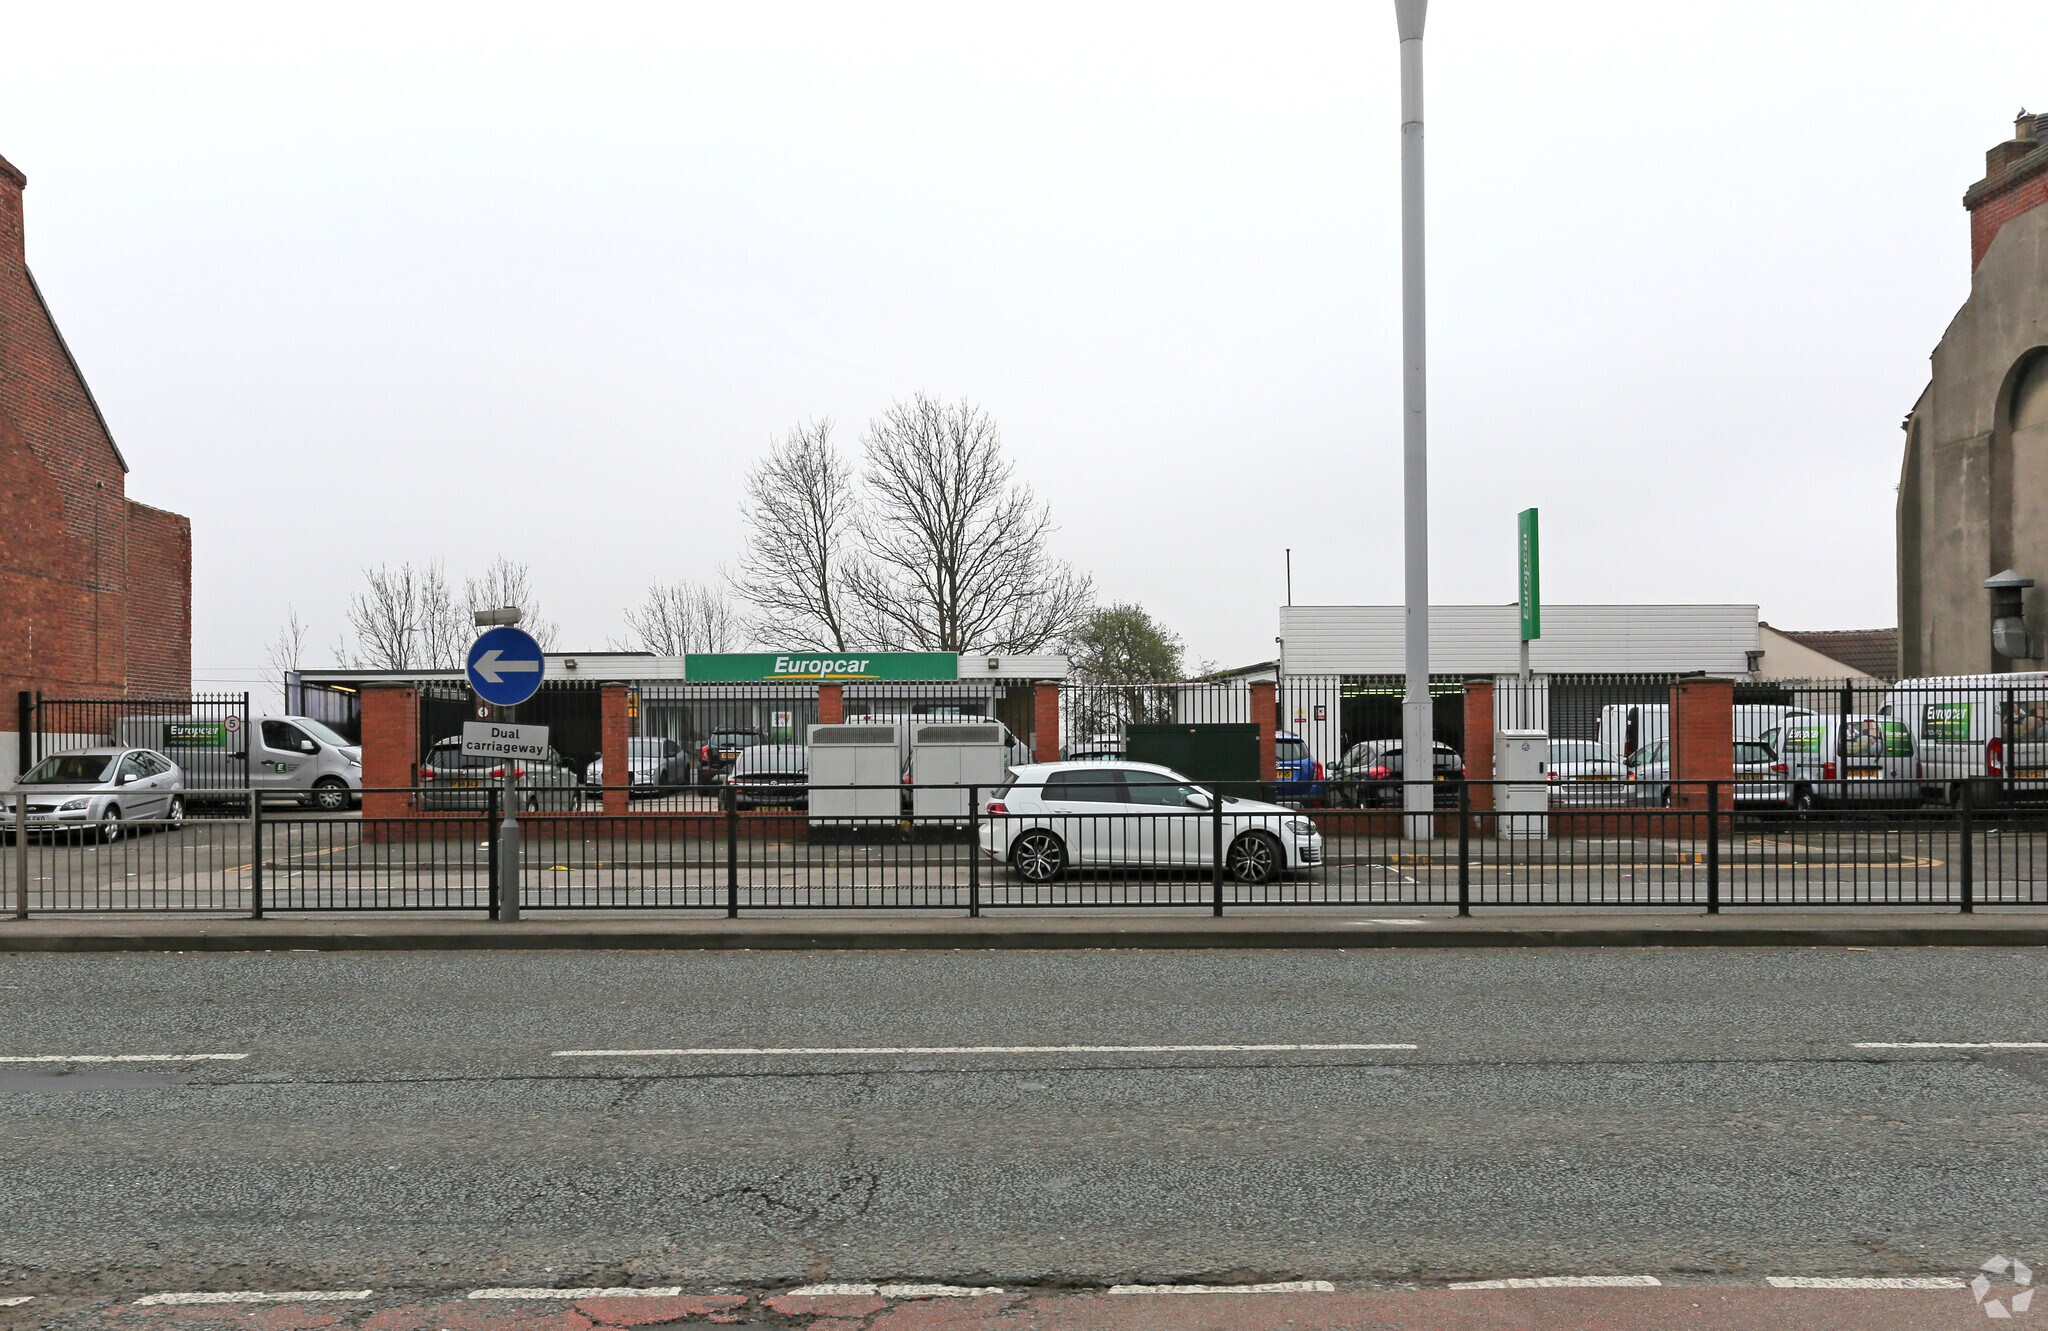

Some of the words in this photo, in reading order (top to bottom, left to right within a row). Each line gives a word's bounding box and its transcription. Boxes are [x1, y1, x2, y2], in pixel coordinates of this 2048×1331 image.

[1523, 532, 1531, 620] Europcar
[774, 656, 869, 678] Europcar
[1927, 706, 1967, 724] Europcar
[229, 720, 236, 728] 5
[171, 726, 219, 738] Europcar
[491, 727, 520, 739] Dual
[1789, 728, 1821, 740] Europca
[466, 741, 544, 756] carriageway
[277, 763, 284, 771] E
